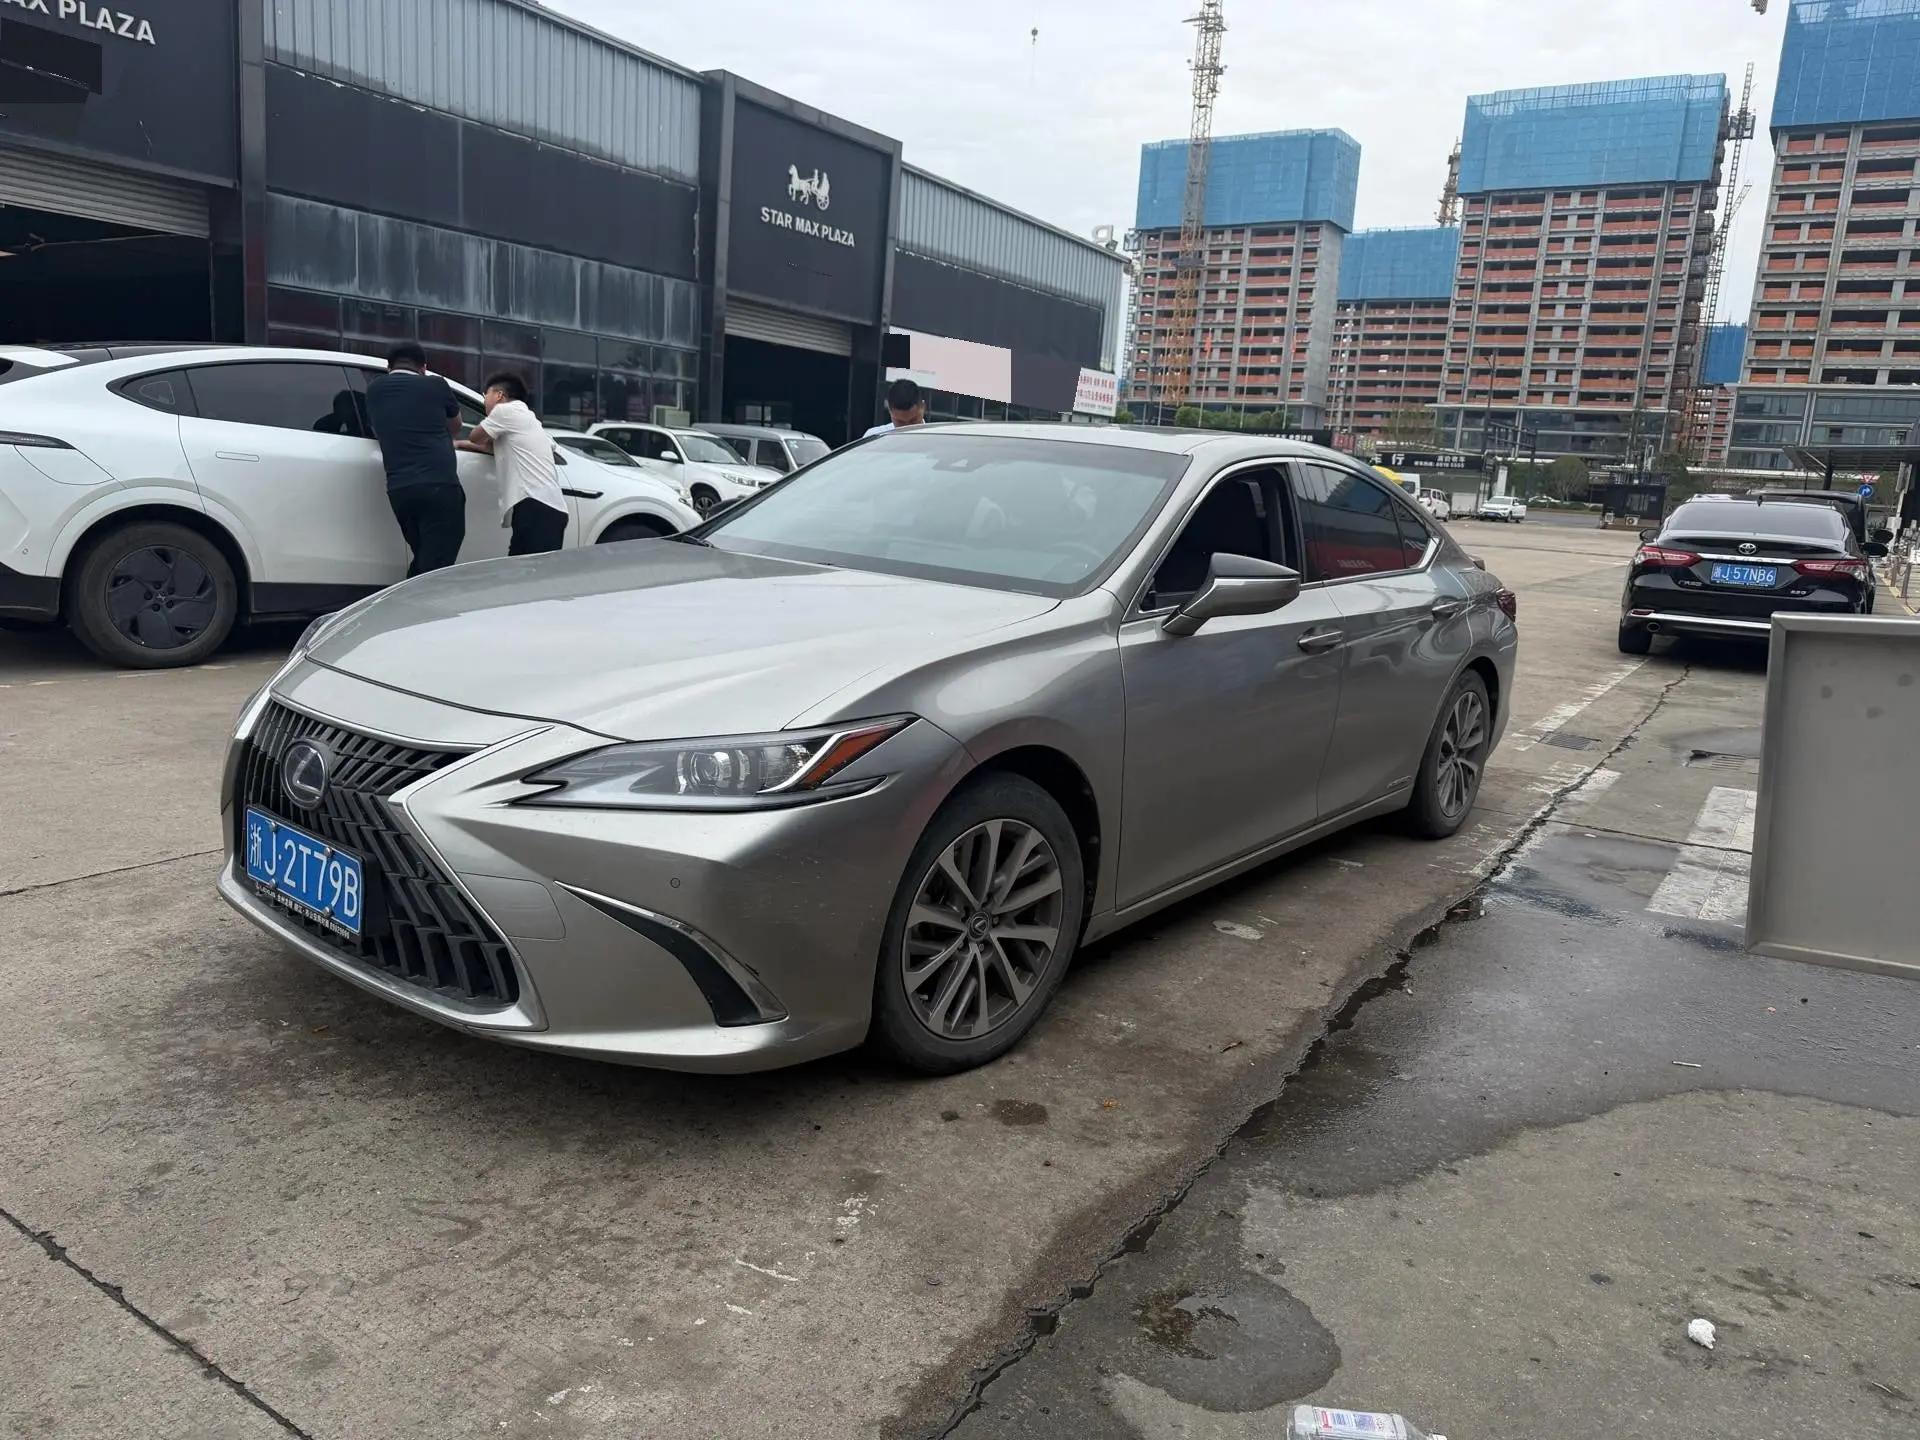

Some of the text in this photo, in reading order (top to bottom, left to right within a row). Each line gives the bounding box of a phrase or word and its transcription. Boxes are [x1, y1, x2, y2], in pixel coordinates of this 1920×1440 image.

[58, 0, 156, 45] PLAZA
[760, 206, 855, 247] STAR MAX PLAZA
